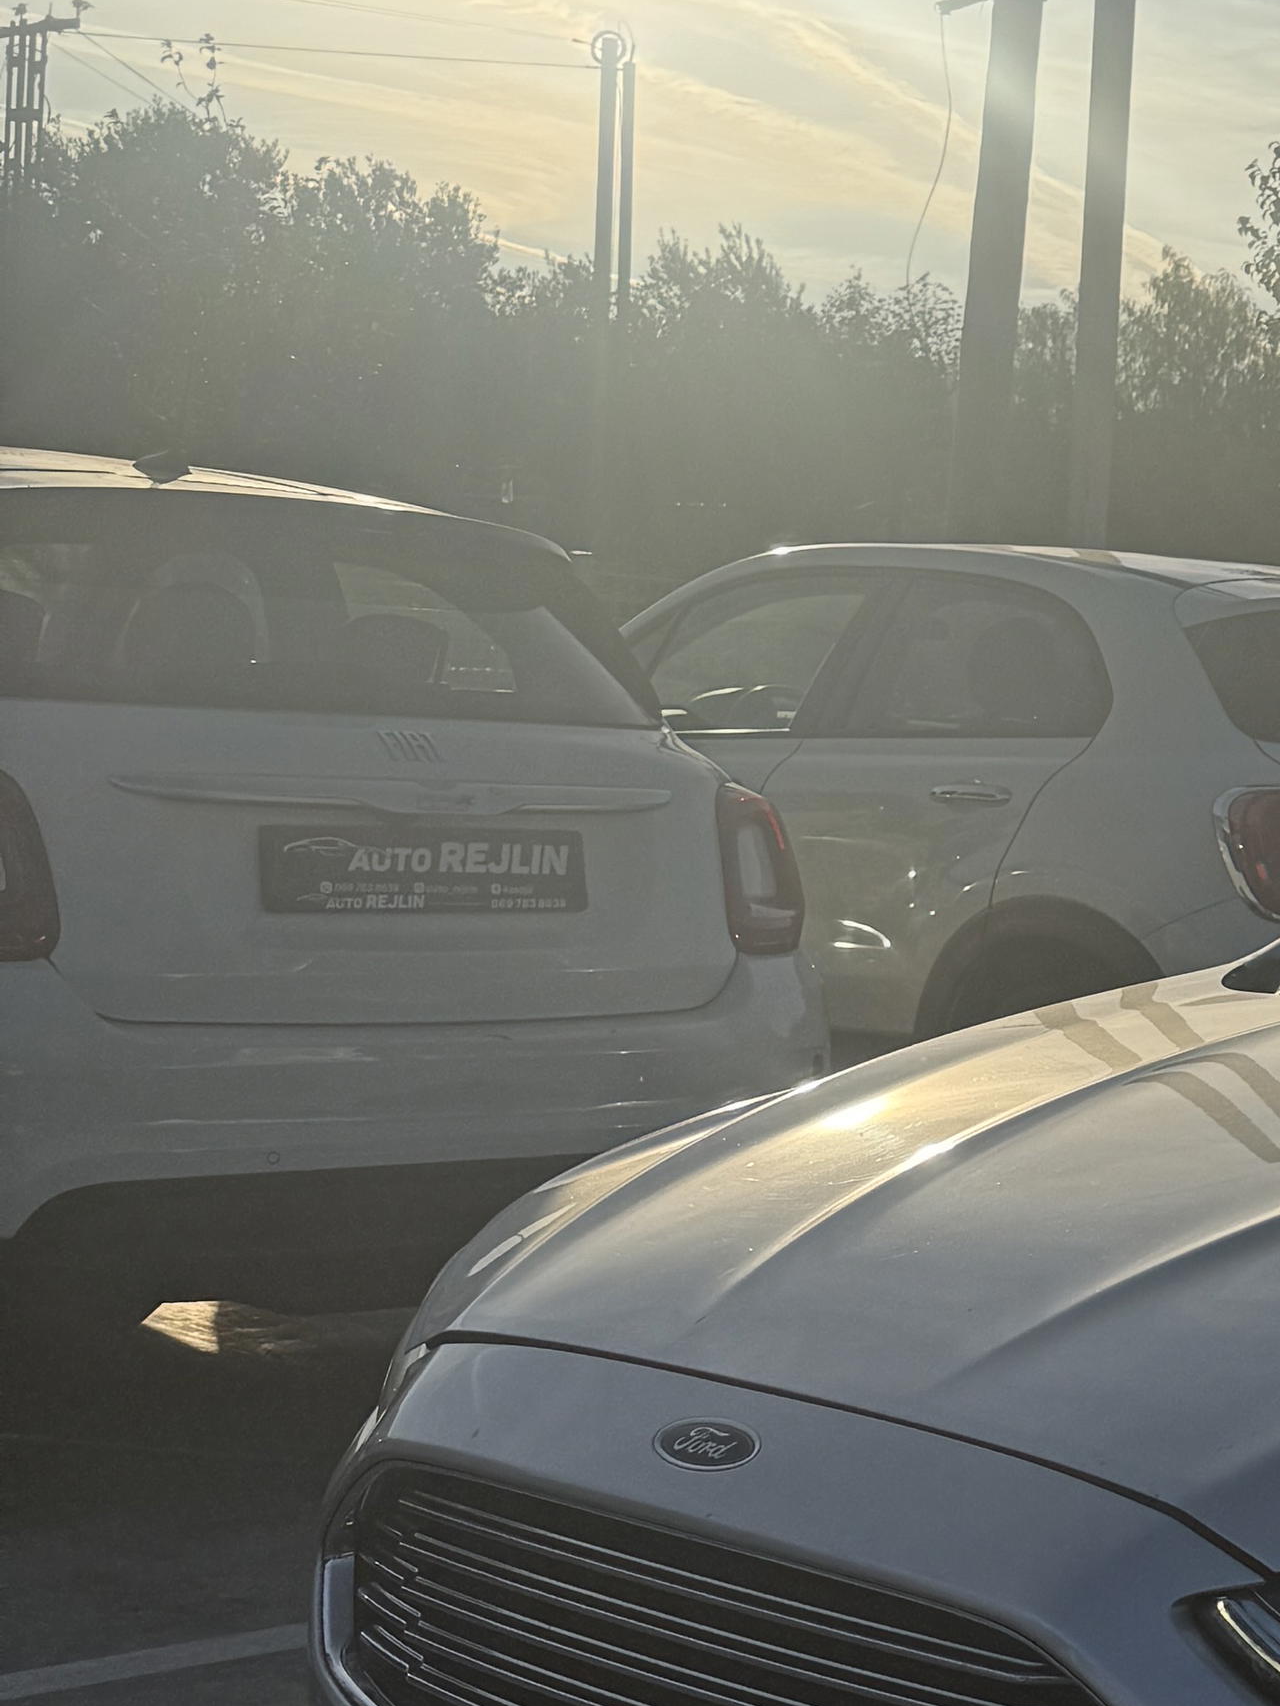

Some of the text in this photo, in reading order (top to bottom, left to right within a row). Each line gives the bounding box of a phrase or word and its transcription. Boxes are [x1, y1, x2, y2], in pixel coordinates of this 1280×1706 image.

[347, 841, 570, 876] AUTO REJLIN
[326, 894, 425, 909] AUTO REJLIN
[673, 1426, 738, 1459] Ford
